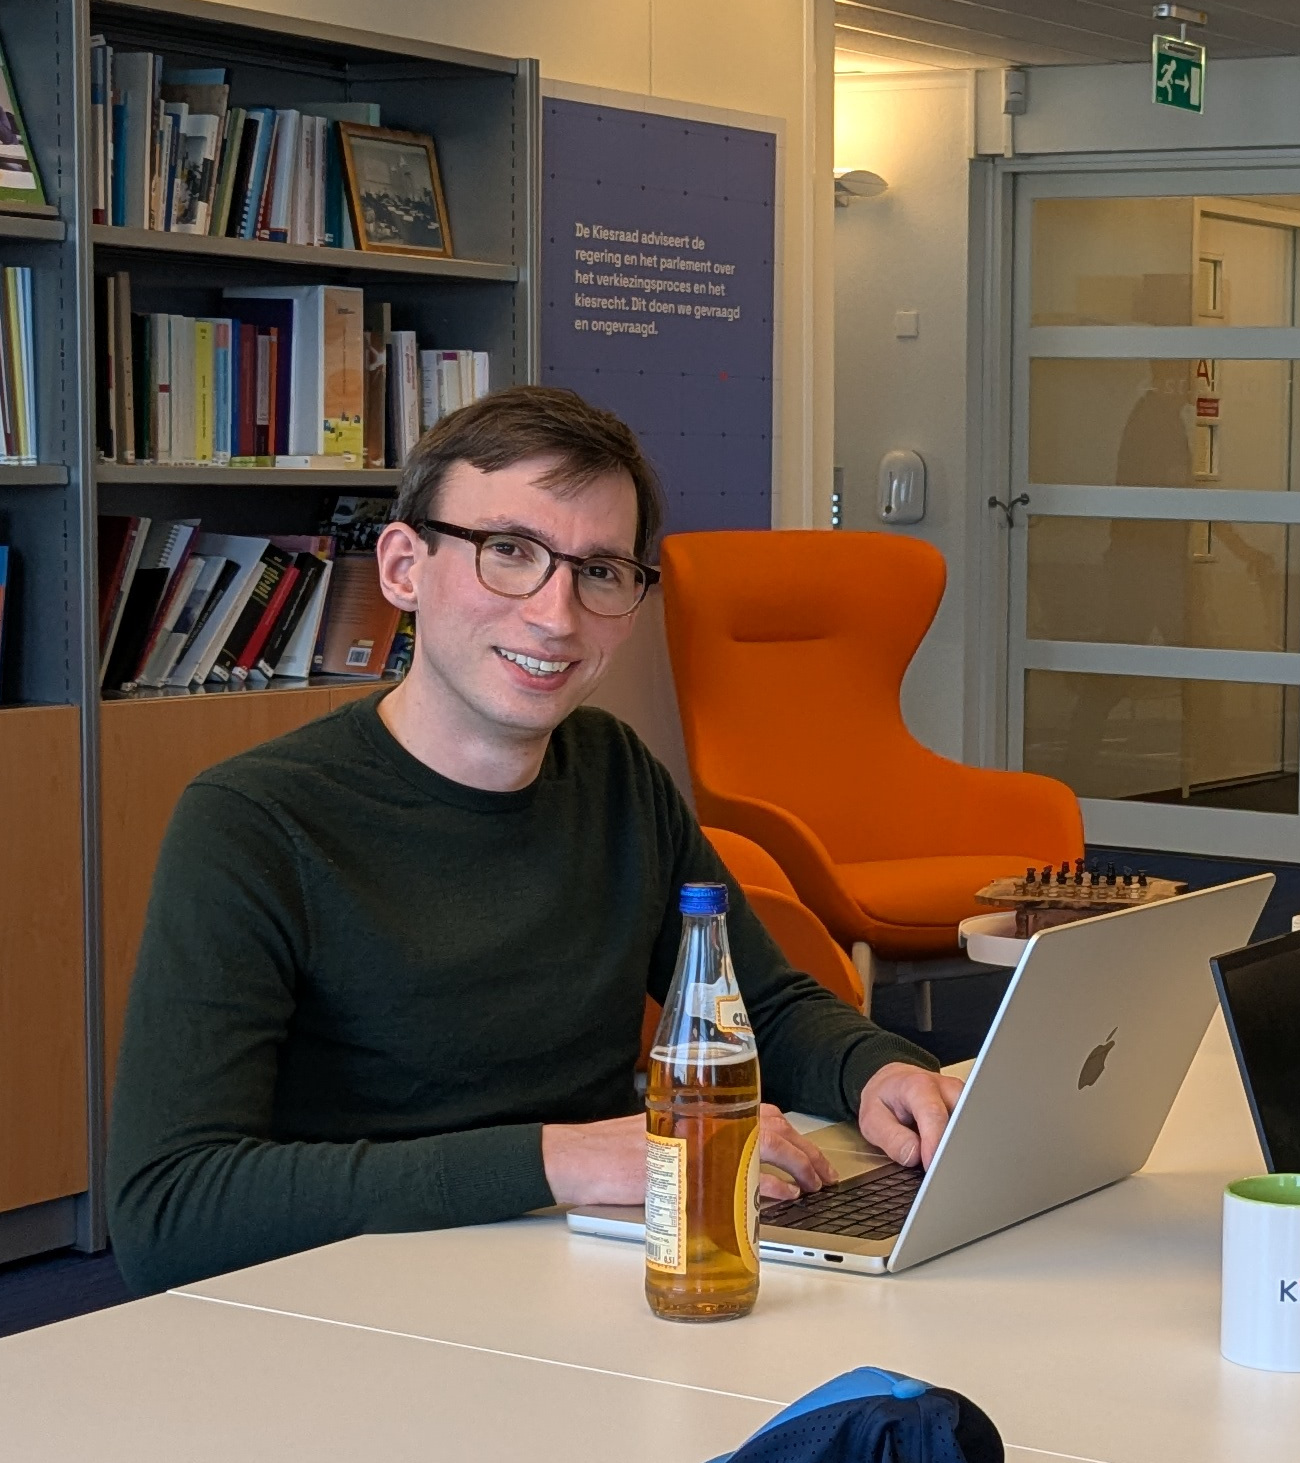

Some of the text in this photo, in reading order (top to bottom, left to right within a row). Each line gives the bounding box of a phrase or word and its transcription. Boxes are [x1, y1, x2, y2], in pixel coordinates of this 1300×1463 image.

[575, 222, 705, 250] De Kiesraad adviseert de
[575, 249, 735, 275] regering en het parlement over
[575, 270, 726, 297] het verkiezingsproces en het
[575, 292, 740, 321] kiesrecht. Dit doen we gevraagd
[574, 319, 659, 338] en ongevraagd.
